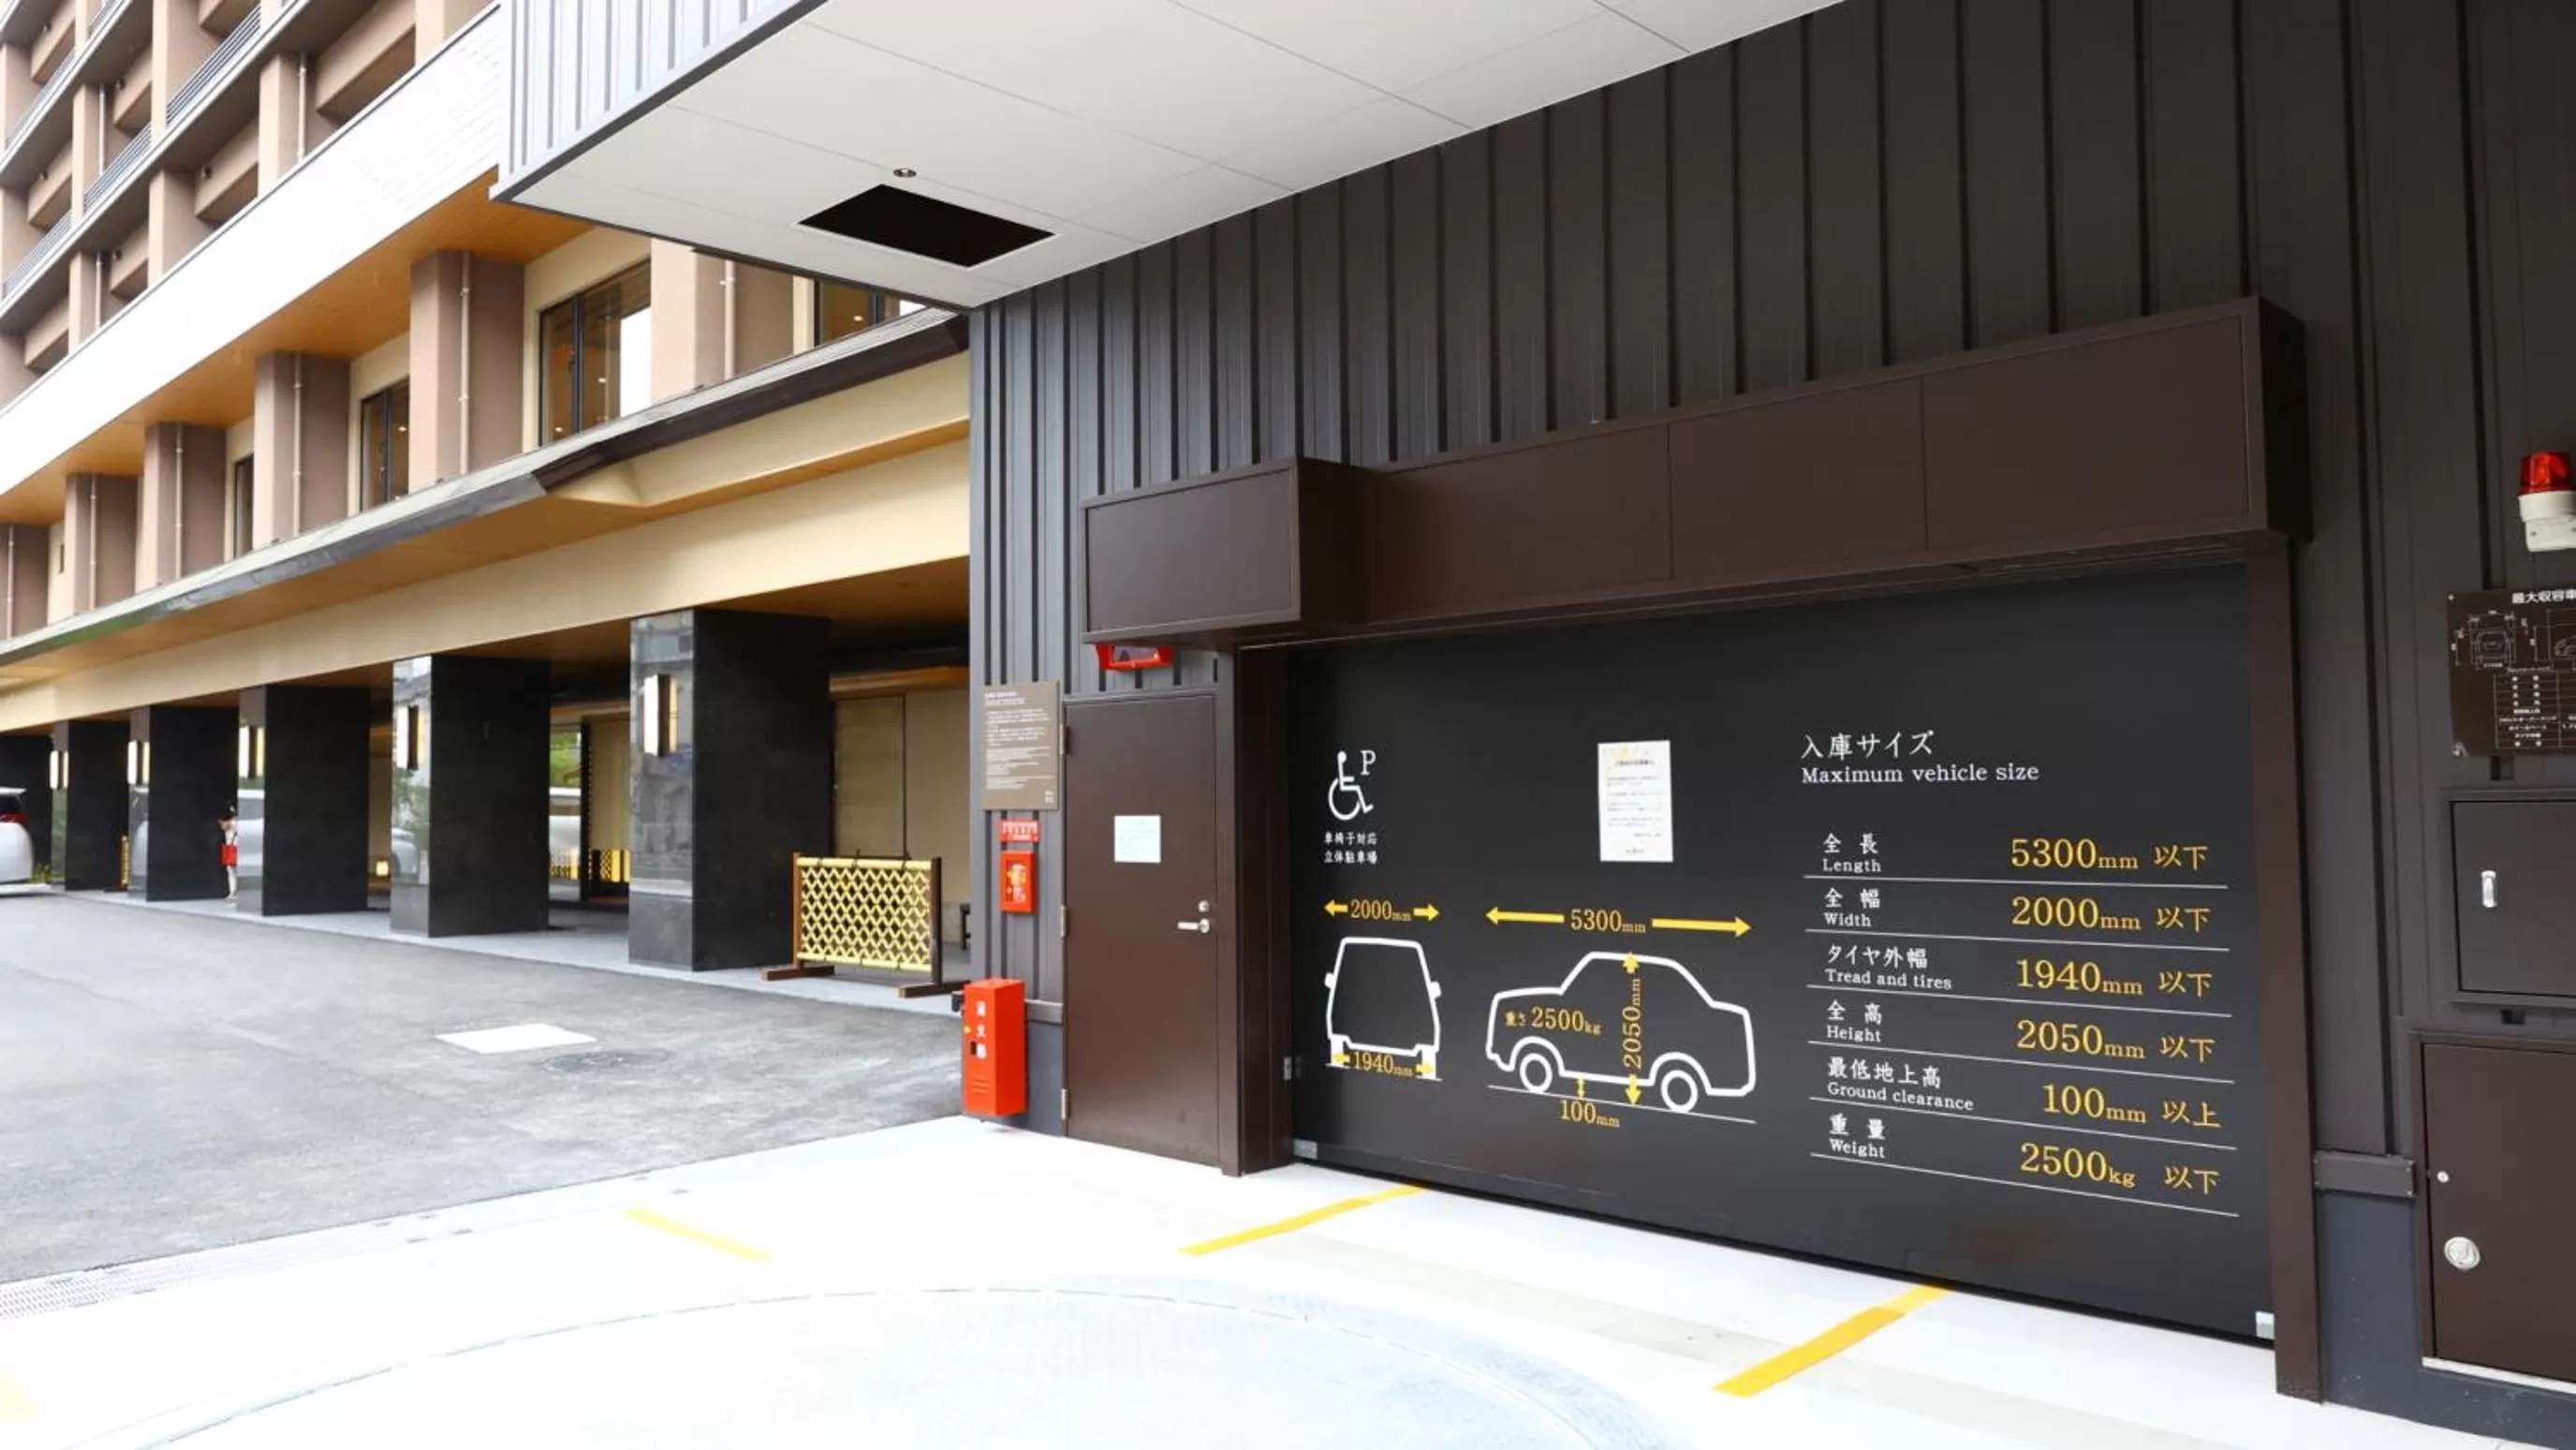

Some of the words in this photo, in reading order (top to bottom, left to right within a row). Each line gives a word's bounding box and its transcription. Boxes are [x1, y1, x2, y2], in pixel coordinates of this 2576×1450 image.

[1801, 730, 1935, 760] 入庫サイズ
[1360, 749, 1376, 776] P
[1801, 765, 1904, 784] Maximum
[1911, 762, 1988, 782] vehicle
[1995, 762, 2039, 781] size
[1822, 857, 1882, 874] Length
[2011, 837, 2139, 869] 5300mm
[2153, 844, 2208, 870] 以下
[1350, 898, 1412, 922] 2000mm
[1570, 908, 1646, 934] 5300mm
[1823, 911, 1872, 927] Width
[2011, 895, 2142, 930] 2000mm
[2156, 906, 2211, 933] 以下
[1825, 944, 1928, 969] タイヤ外幅
[1824, 968, 1872, 984] Tread
[1876, 972, 1907, 987] and
[1913, 973, 1952, 990] tires
[2017, 959, 2143, 995] 1940mm
[2157, 970, 2213, 998] 以下
[1622, 978, 1642, 1070] 2050mm
[1825, 1025, 1882, 1043] Height
[2016, 1019, 2145, 1059] 2050mm
[2160, 1035, 2215, 1063] 以下
[1354, 1050, 1413, 1076] 1940mm
[1827, 1056, 1942, 1088] 最低地上高
[1827, 1082, 1888, 1102] Ground
[1892, 1088, 1974, 1111] clearance
[2041, 1084, 2146, 1124] 100mm
[2161, 1101, 2221, 1128] 以上
[1560, 1099, 1620, 1128] 100mm
[1829, 1137, 1885, 1160] Weight
[2020, 1142, 2136, 1189] 2500kg
[2164, 1166, 2219, 1195] 以下
